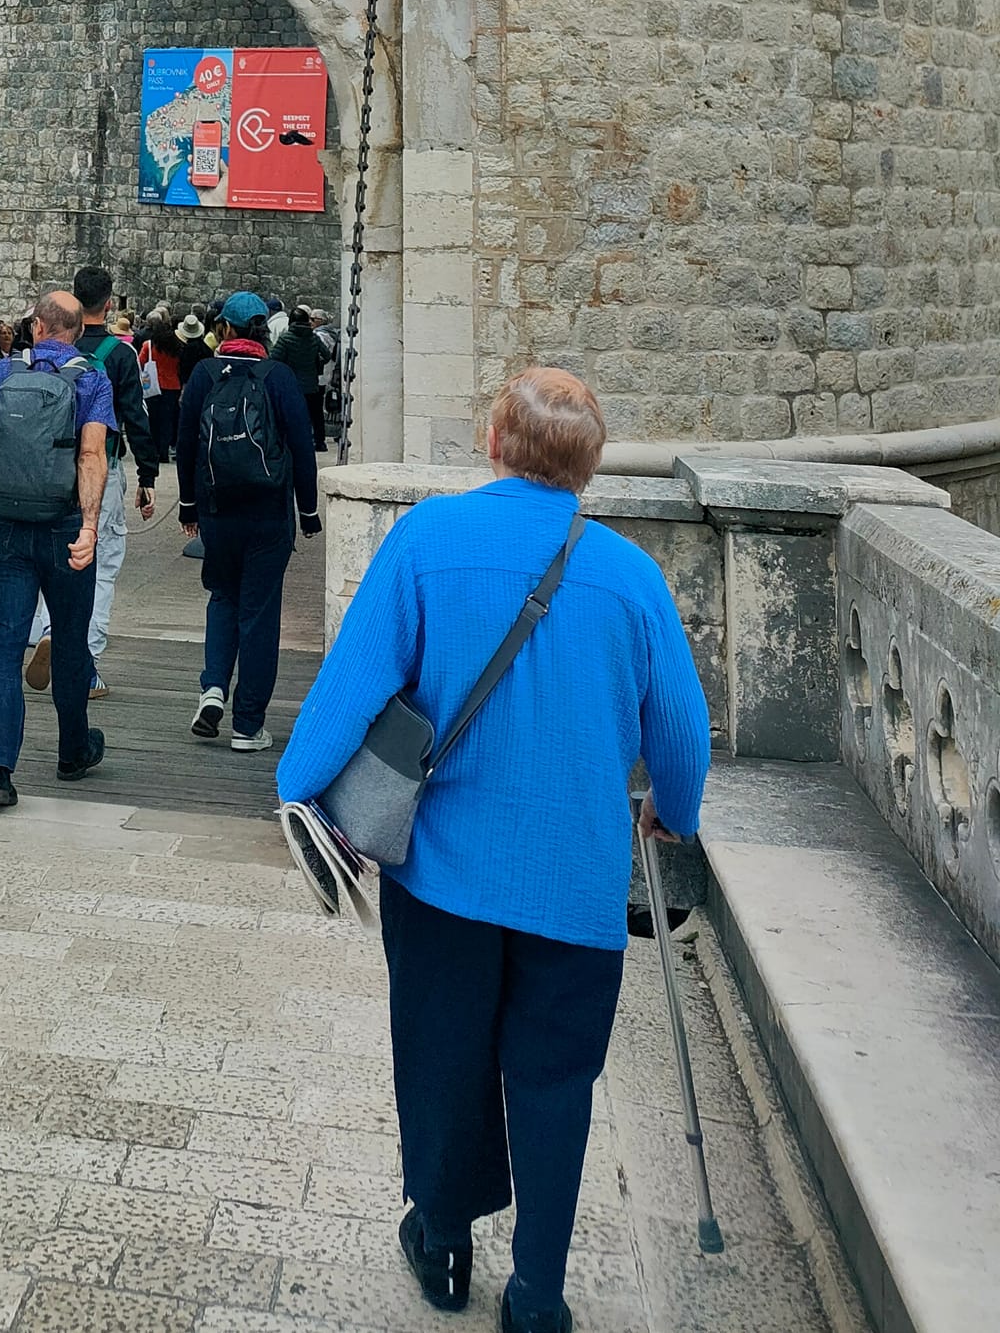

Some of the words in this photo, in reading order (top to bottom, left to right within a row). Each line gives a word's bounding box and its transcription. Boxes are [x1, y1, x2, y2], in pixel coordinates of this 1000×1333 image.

[199, 69, 213, 83] 40
[213, 65, 223, 77] €
[206, 80, 220, 89] ONLY
